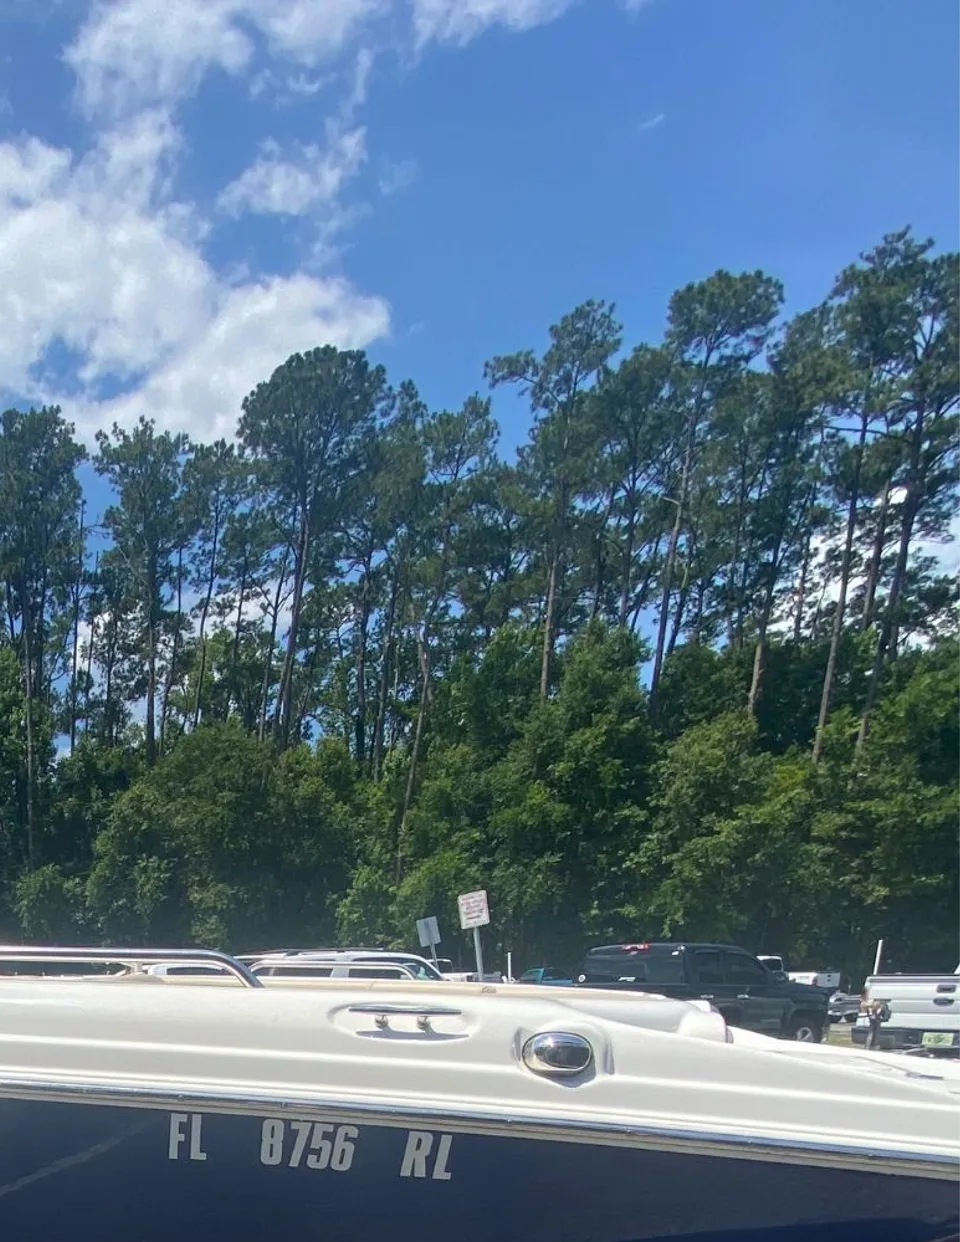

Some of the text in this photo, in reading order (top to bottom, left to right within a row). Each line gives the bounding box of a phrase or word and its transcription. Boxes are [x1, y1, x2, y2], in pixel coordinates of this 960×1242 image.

[168, 1113, 453, 1181] FL 8756 RL
